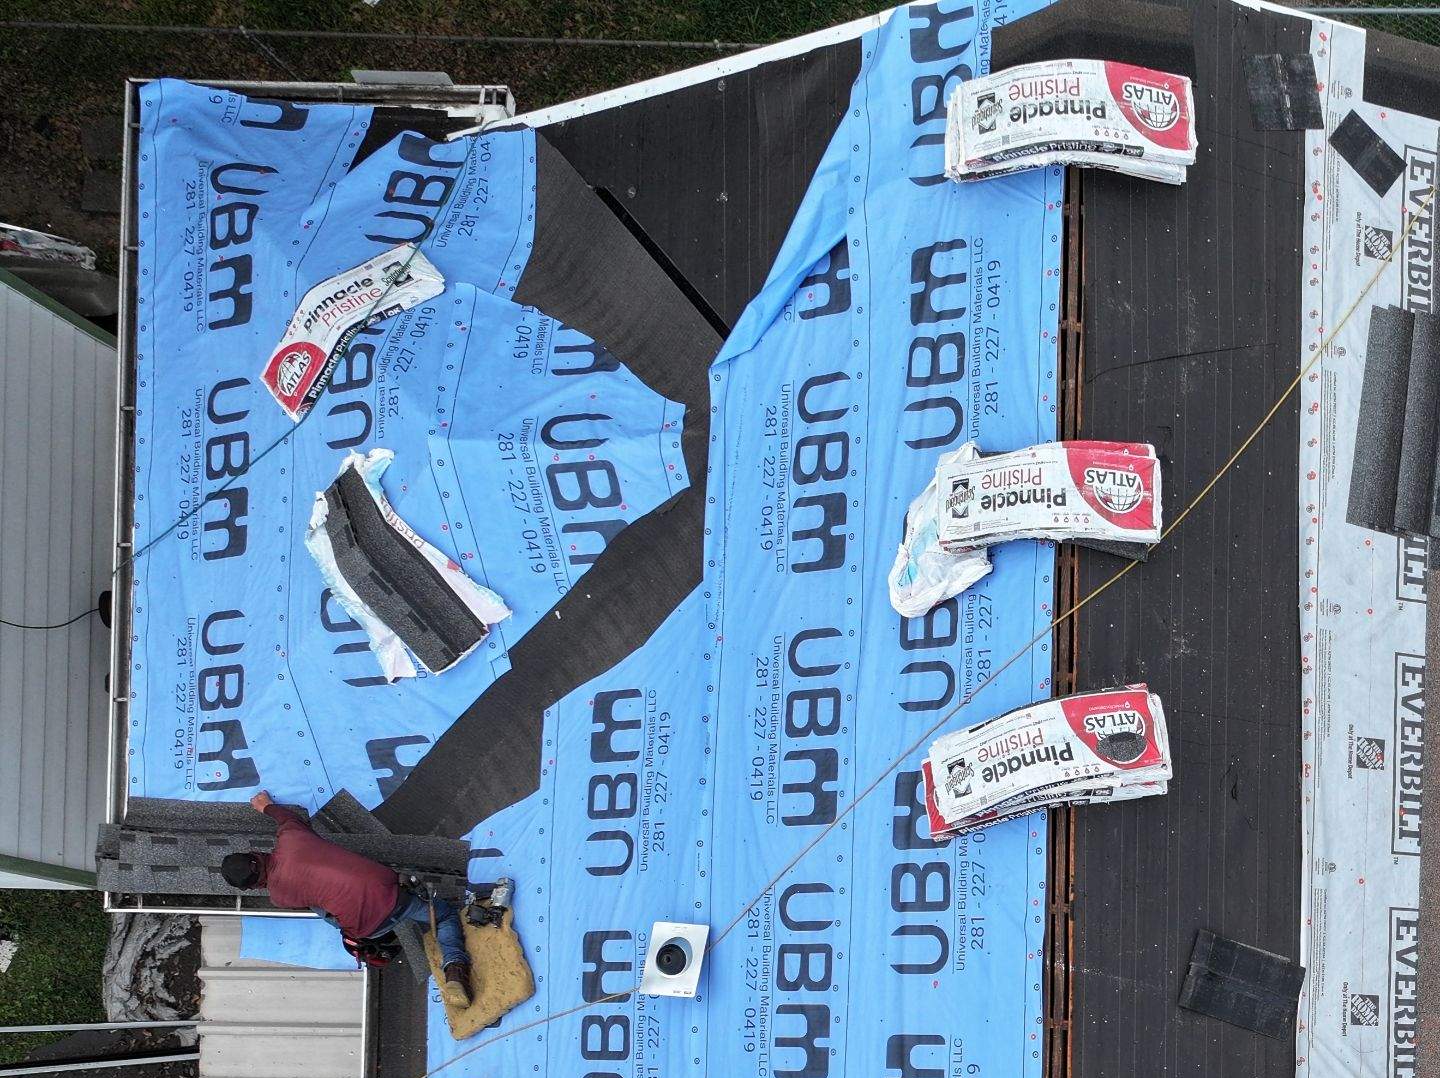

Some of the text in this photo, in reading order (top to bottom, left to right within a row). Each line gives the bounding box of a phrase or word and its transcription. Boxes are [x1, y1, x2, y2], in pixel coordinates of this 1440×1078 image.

[1008, 77, 1080, 102] Pristine
[1124, 84, 1172, 106] ATLAS
[1009, 99, 1107, 124] Pinnacle
[303, 277, 374, 333] Pinnacle
[321, 287, 383, 327] Pristine
[970, 238, 984, 439] Universal Building Materials LLC
[285, 351, 312, 395] ATLAS
[309, 352, 341, 398] Pinnacle
[763, 405, 777, 438] 281
[762, 456, 776, 488] 227
[776, 384, 791, 573] Universal Building Materials LLC
[981, 467, 1042, 492] Pristine
[1086, 469, 1137, 487] ATLAS
[497, 432, 517, 461] 281
[508, 480, 531, 514] 227
[522, 530, 548, 574] 0419
[519, 418, 569, 596] Universal Building Materials LLC
[980, 487, 1067, 513] Pinnacle
[760, 505, 774, 551] 0419
[1085, 712, 1136, 732] ATLAS
[977, 727, 1044, 765] Pristine
[1398, 663, 1425, 842] EVERBILT
[981, 742, 1074, 784] Pinnacle
[1351, 994, 1379, 1026] HOME
[1351, 1006, 1367, 1026] DEPOT
[1364, 998, 1377, 1010] THE
[953, 1038, 962, 1063] LLC
